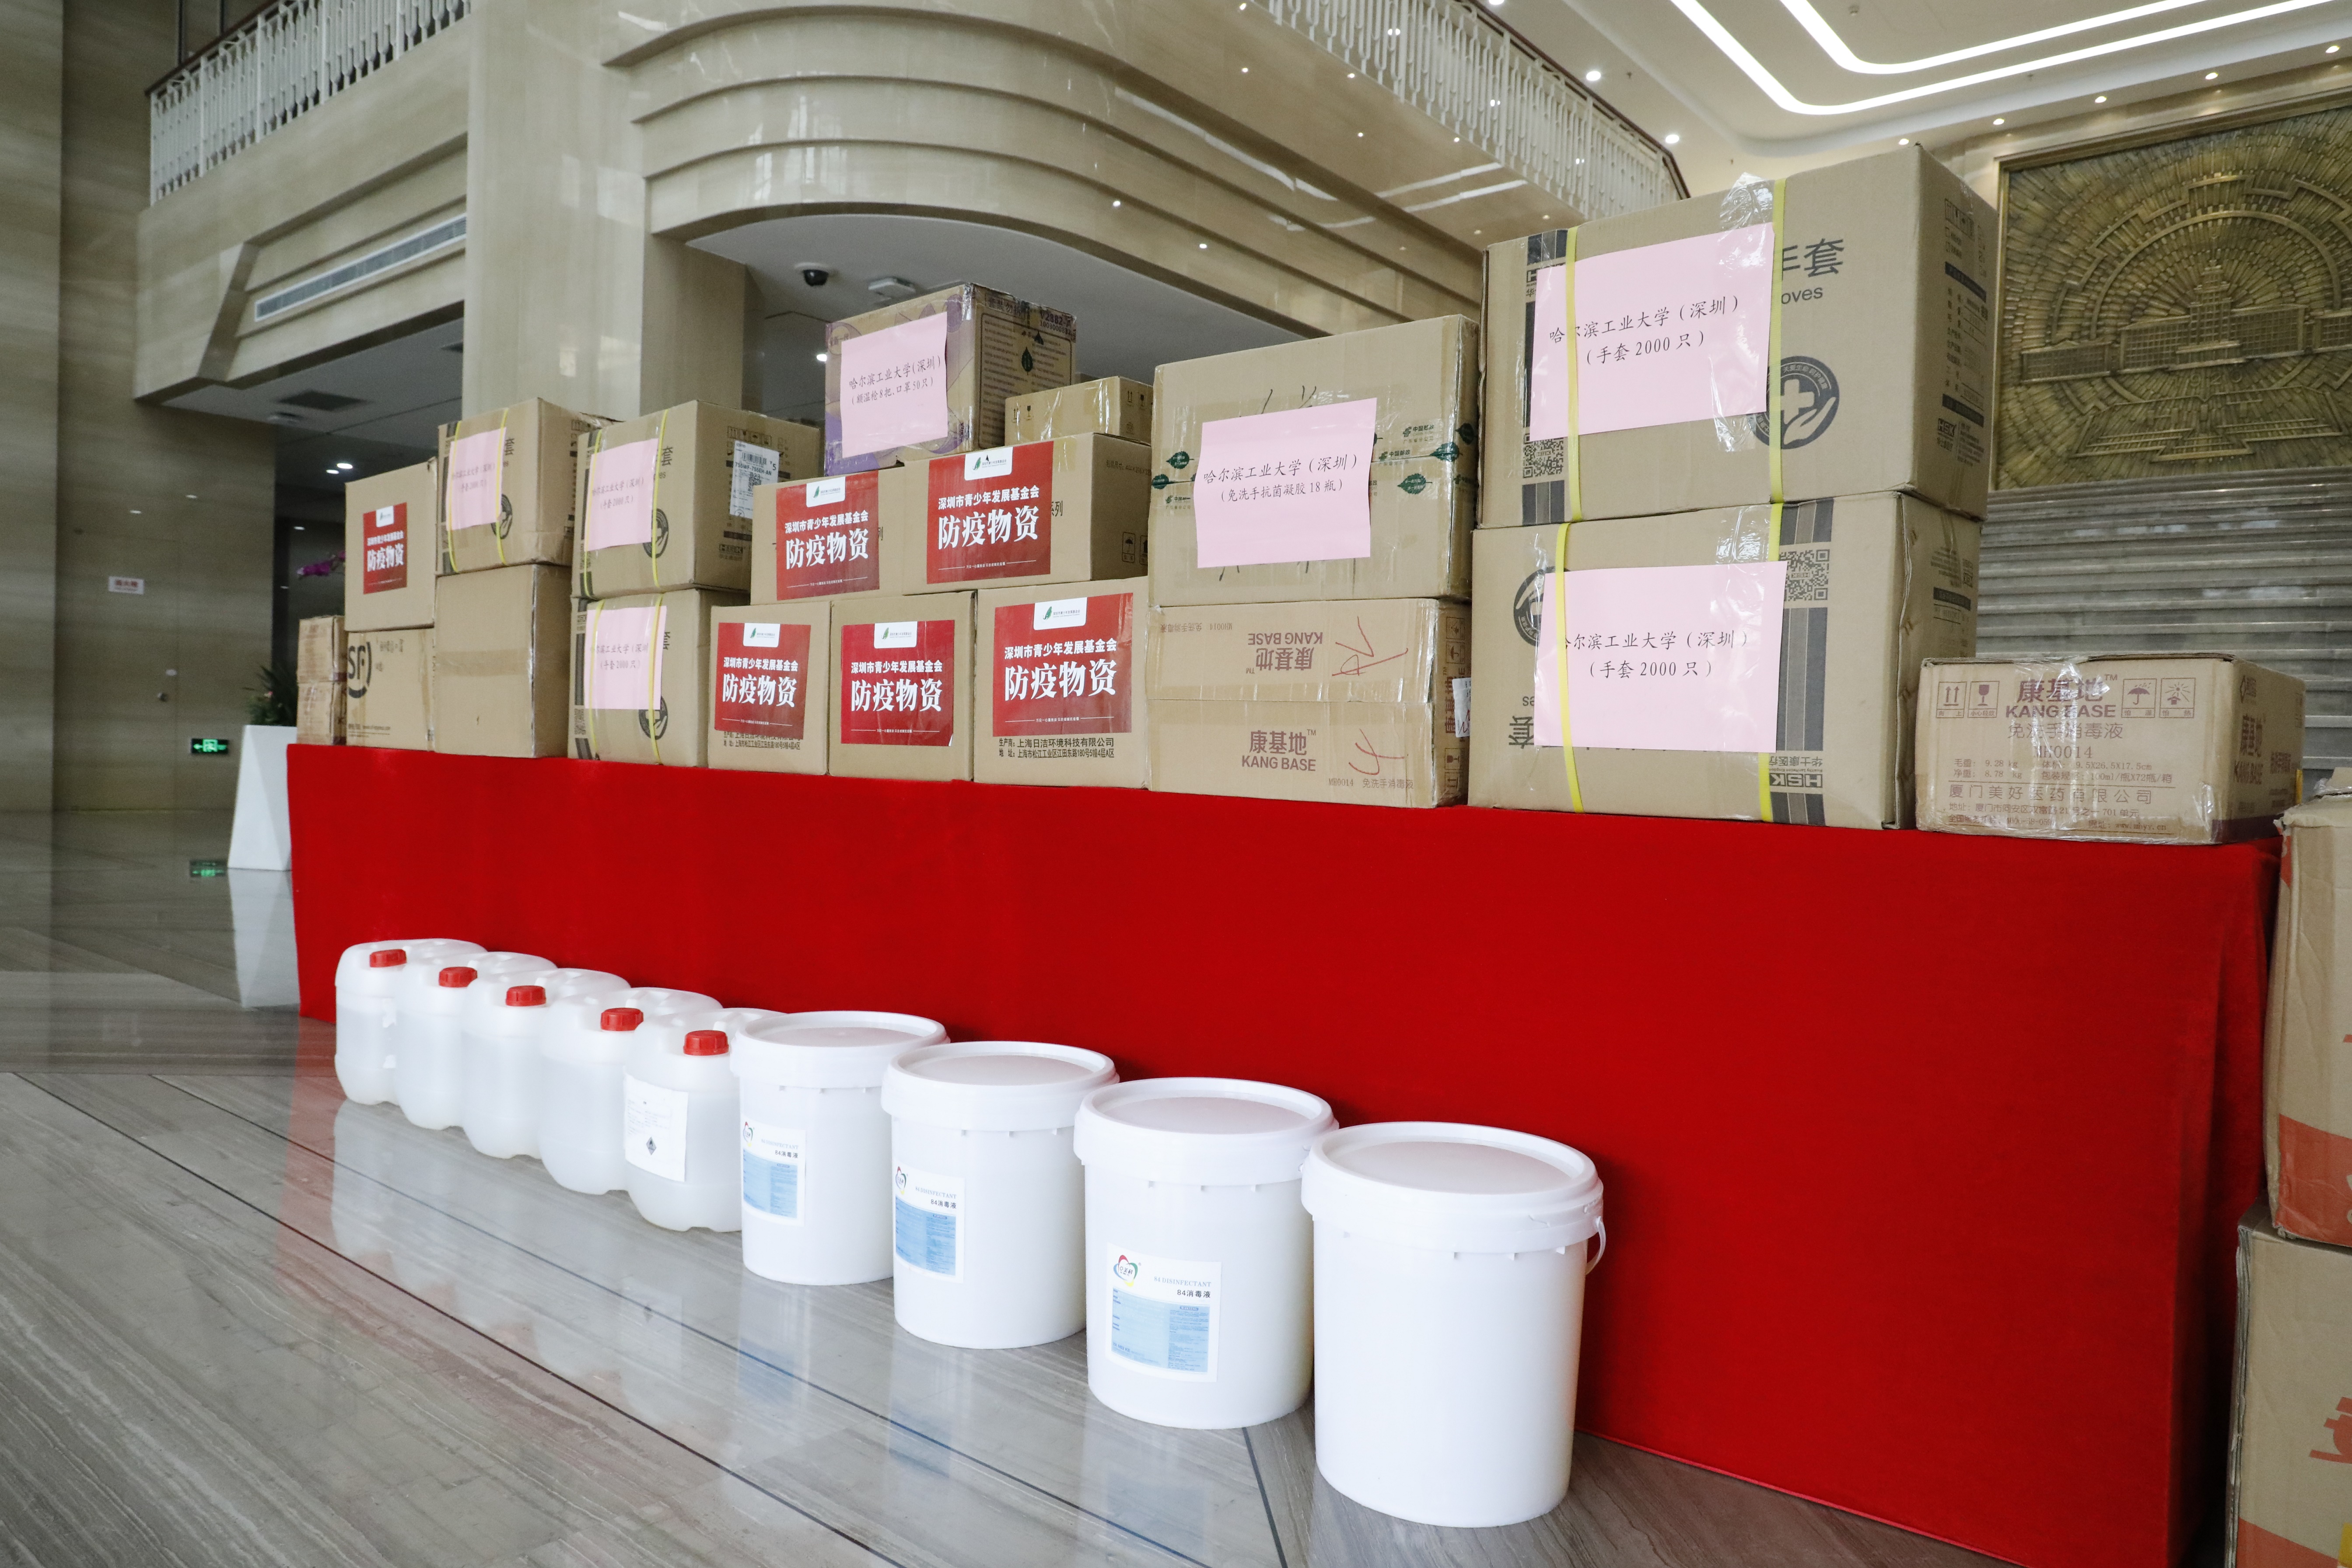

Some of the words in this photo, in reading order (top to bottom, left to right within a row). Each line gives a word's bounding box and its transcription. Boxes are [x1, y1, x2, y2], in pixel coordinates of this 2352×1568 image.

[1781, 286, 1823, 305] oves
[1204, 454, 1358, 484] 哈尔滨工业大学（深圳）
[938, 485, 1040, 510] 深圳市青少年发展基金会
[785, 510, 868, 534] 深圳市青少年发展基金会
[938, 505, 1040, 550] 防疫物资
[786, 528, 869, 570] 防疫物资
[367, 543, 404, 572] 防疫物资
[1248, 633, 1281, 645] BASE
[1284, 632, 1323, 644] KANG
[1004, 637, 1117, 660] 深圳市青少年发展基金会
[724, 657, 798, 672] 深圳市青少年发展基金会
[1256, 647, 1314, 671] 康基地
[851, 660, 943, 674] 深圳市青少年发展基金会
[1004, 658, 1117, 701] 防疫物资
[722, 673, 798, 708] 防疫物资
[851, 678, 942, 712] 防疫物资
[2016, 678, 2104, 703] 康基地
[2006, 705, 2059, 718] KANG
[2064, 704, 2116, 718] BASE
[2007, 722, 2123, 739] 免洗手消毒液
[999, 738, 1015, 748] 生产商：
[1017, 737, 1114, 748] 上海日洁环境科技有限公司
[1249, 730, 1307, 756] 康基地
[1242, 755, 1278, 769] KANG
[1281, 757, 1316, 771] BASE
[1769, 756, 1823, 766] 华士康医疗
[2076, 761, 2152, 770] 9.5X26.5X17.5cm
[1329, 778, 1354, 786] MH0014
[1770, 774, 1822, 787] HSK
[2012, 771, 2023, 779] kg
[775, 1150, 798, 1158] 84消毒液
[920, 1188, 957, 1199] DISINFECTANT
[931, 1199, 957, 1209] 84消毒液
[1162, 1278, 1211, 1287] DISINFECTANT
[1177, 1289, 1211, 1298] 84消毒液
